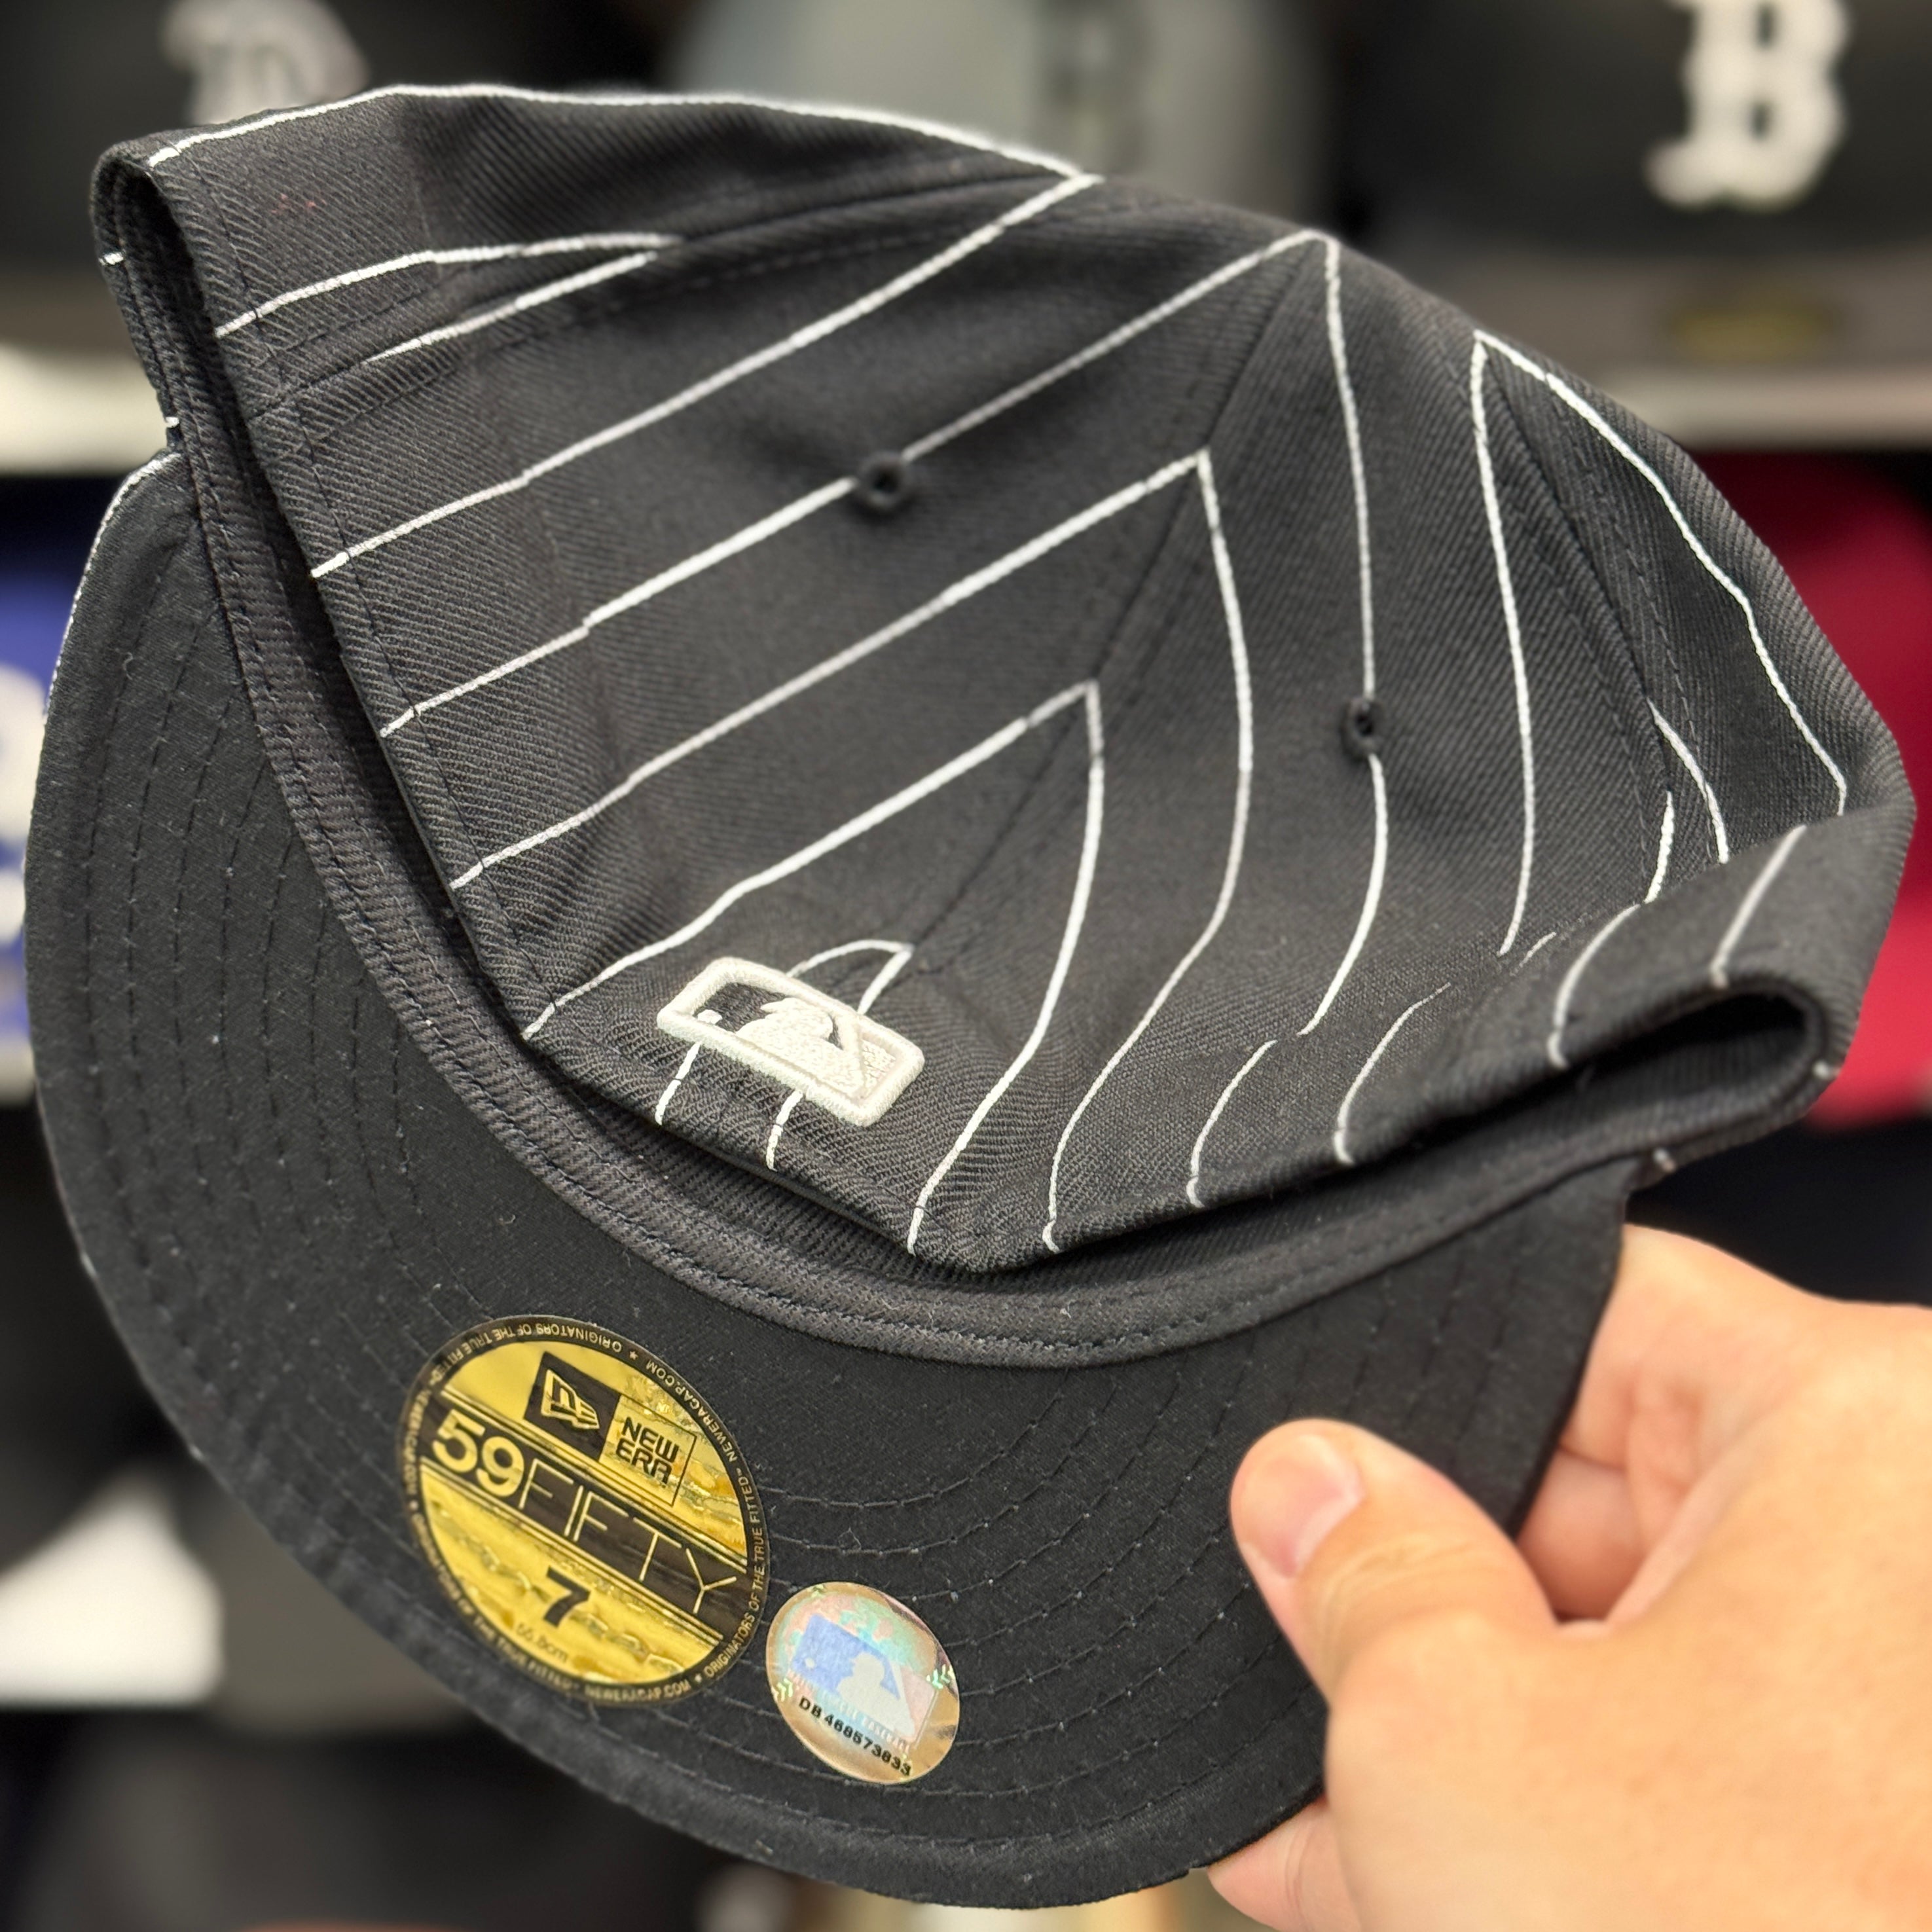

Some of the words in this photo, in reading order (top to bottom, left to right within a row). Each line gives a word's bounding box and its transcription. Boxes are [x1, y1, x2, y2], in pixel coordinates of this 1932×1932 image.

[1642, 0, 1850, 211] B
[462, 1332, 492, 1351] TRUE
[492, 1325, 515, 1341] THE
[518, 1323, 532, 1336] OF
[536, 1322, 623, 1353] ORIGINATORS
[646, 1359, 738, 1463] NEWERACAP.COM
[621, 1416, 679, 1463] NEW
[615, 1437, 672, 1485] ERA
[432, 1408, 737, 1614] 59FIFTY
[752, 1527, 765, 1562] TRUE
[752, 1565, 765, 1591] THE
[543, 1565, 591, 1628] 7
[748, 1592, 761, 1611] OF
[704, 1612, 755, 1678] ORIGINATORS
[798, 1695, 822, 1720] DB
